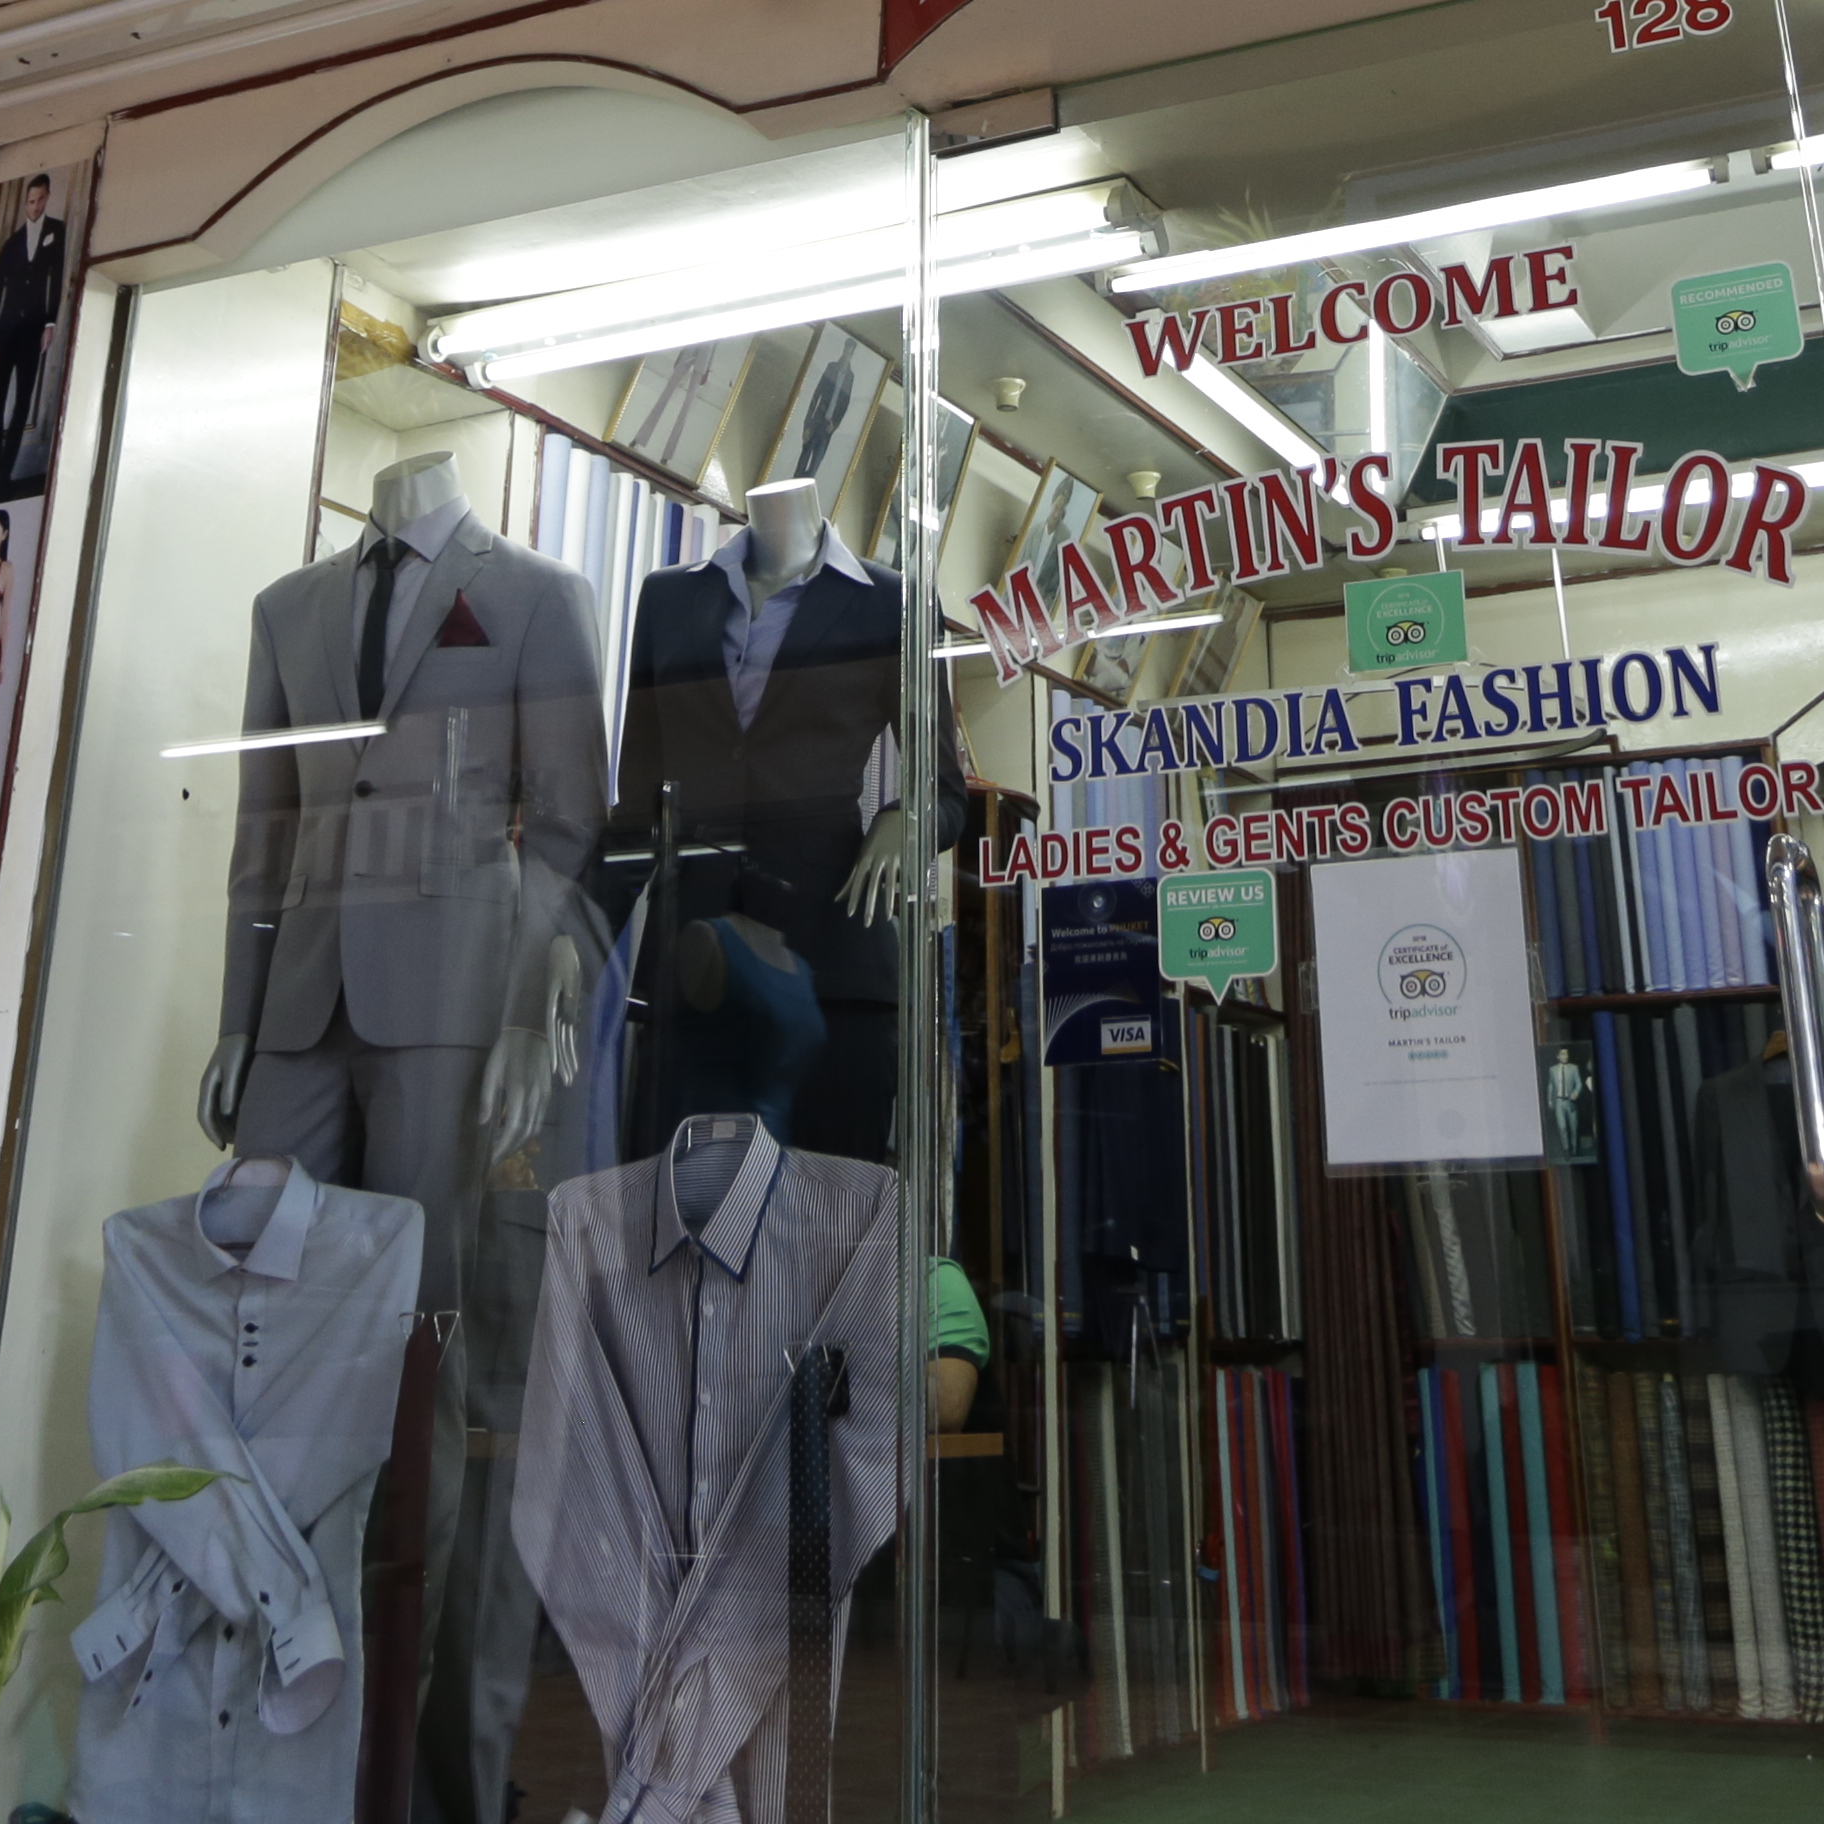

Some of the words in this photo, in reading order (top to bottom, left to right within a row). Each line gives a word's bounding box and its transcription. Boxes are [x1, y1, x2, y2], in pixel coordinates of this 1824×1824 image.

[1678, 277, 1784, 306] RECOMMENDED
[1123, 243, 1578, 379] WELCOME
[1708, 334, 1771, 353] tripadvisor
[969, 449, 1398, 688] MARTIN'S
[1436, 436, 1812, 589] TAILOR
[1376, 604, 1433, 618] EXCELLENCE
[1375, 649, 1437, 665] tripadvisor
[1048, 684, 1363, 785] SKANDIA
[1393, 641, 1723, 750] FASHION
[977, 823, 1145, 889] LADIES
[1155, 818, 1191, 871] &
[1203, 799, 1372, 868] GENTS
[1382, 781, 1608, 850] CUSTOM
[1166, 887, 1235, 906] REVIEW
[1240, 885, 1265, 901] US
[1051, 926, 1095, 939] Welcome
[1097, 924, 1108, 935] to
[1189, 945, 1246, 961] tripadvisor
[1392, 944, 1439, 956] CERTIFICATE
[1441, 943, 1448, 952] of
[1388, 951, 1454, 966] EXCELLENCE
[1389, 1004, 1457, 1021] tripadvisor
[1109, 1027, 1145, 1042] VISA
[1387, 1037, 1432, 1048] MARTIN'S
[1434, 1036, 1466, 1045] TAILOR
